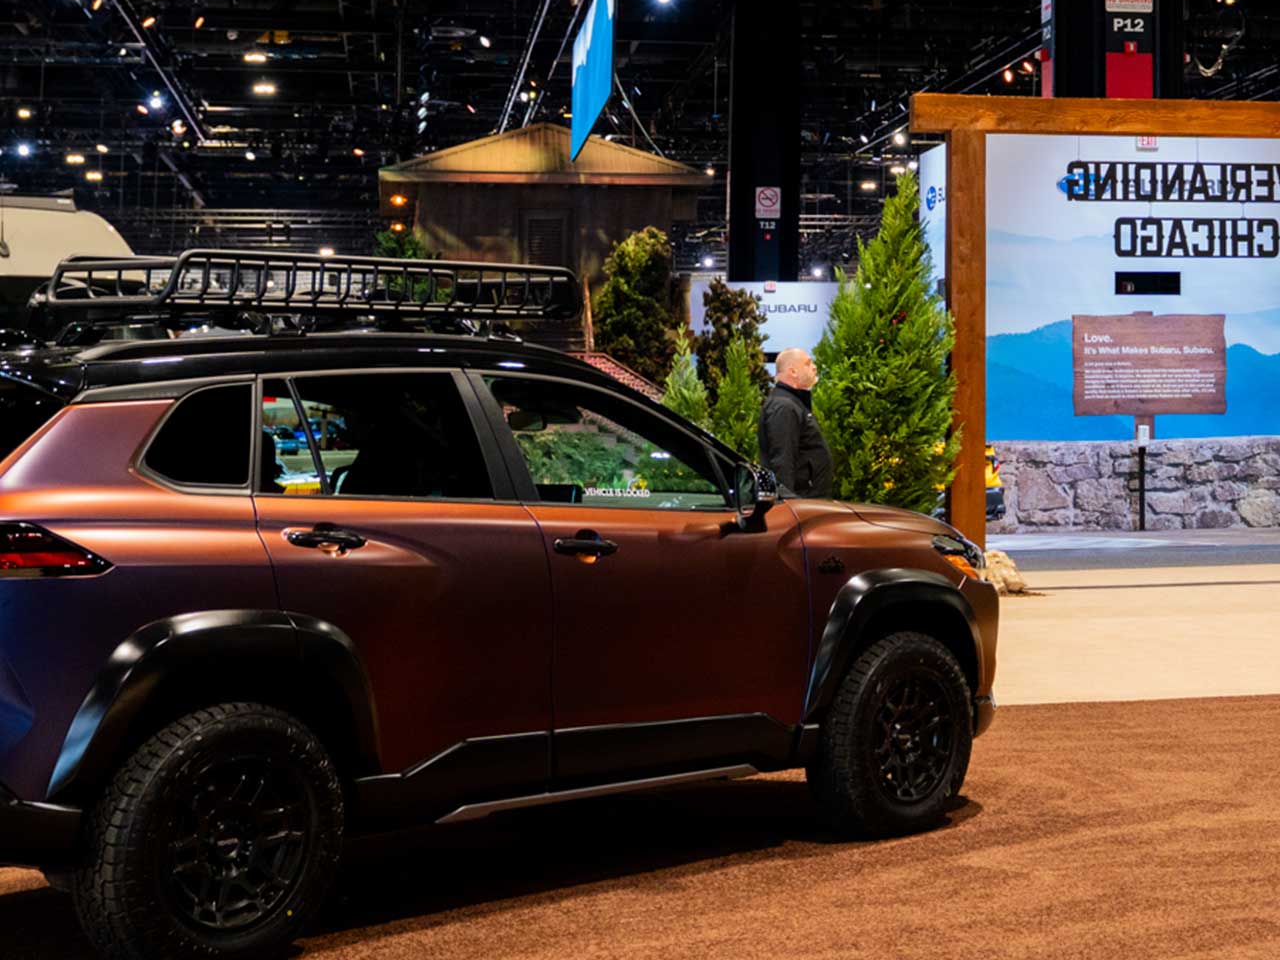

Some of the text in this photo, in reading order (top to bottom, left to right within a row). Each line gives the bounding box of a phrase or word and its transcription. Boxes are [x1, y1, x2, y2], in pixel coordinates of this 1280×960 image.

[1113, 18, 1145, 32] P12
[759, 221, 776, 229] T12
[1084, 333, 1113, 343] Love.
[1084, 346, 1097, 355] It's
[1098, 346, 1120, 355] What
[1121, 346, 1149, 355] Makes
[1183, 346, 1215, 355] Subaru.
[584, 488, 613, 496] VEHICLE
[623, 489, 650, 497] LOCKED
